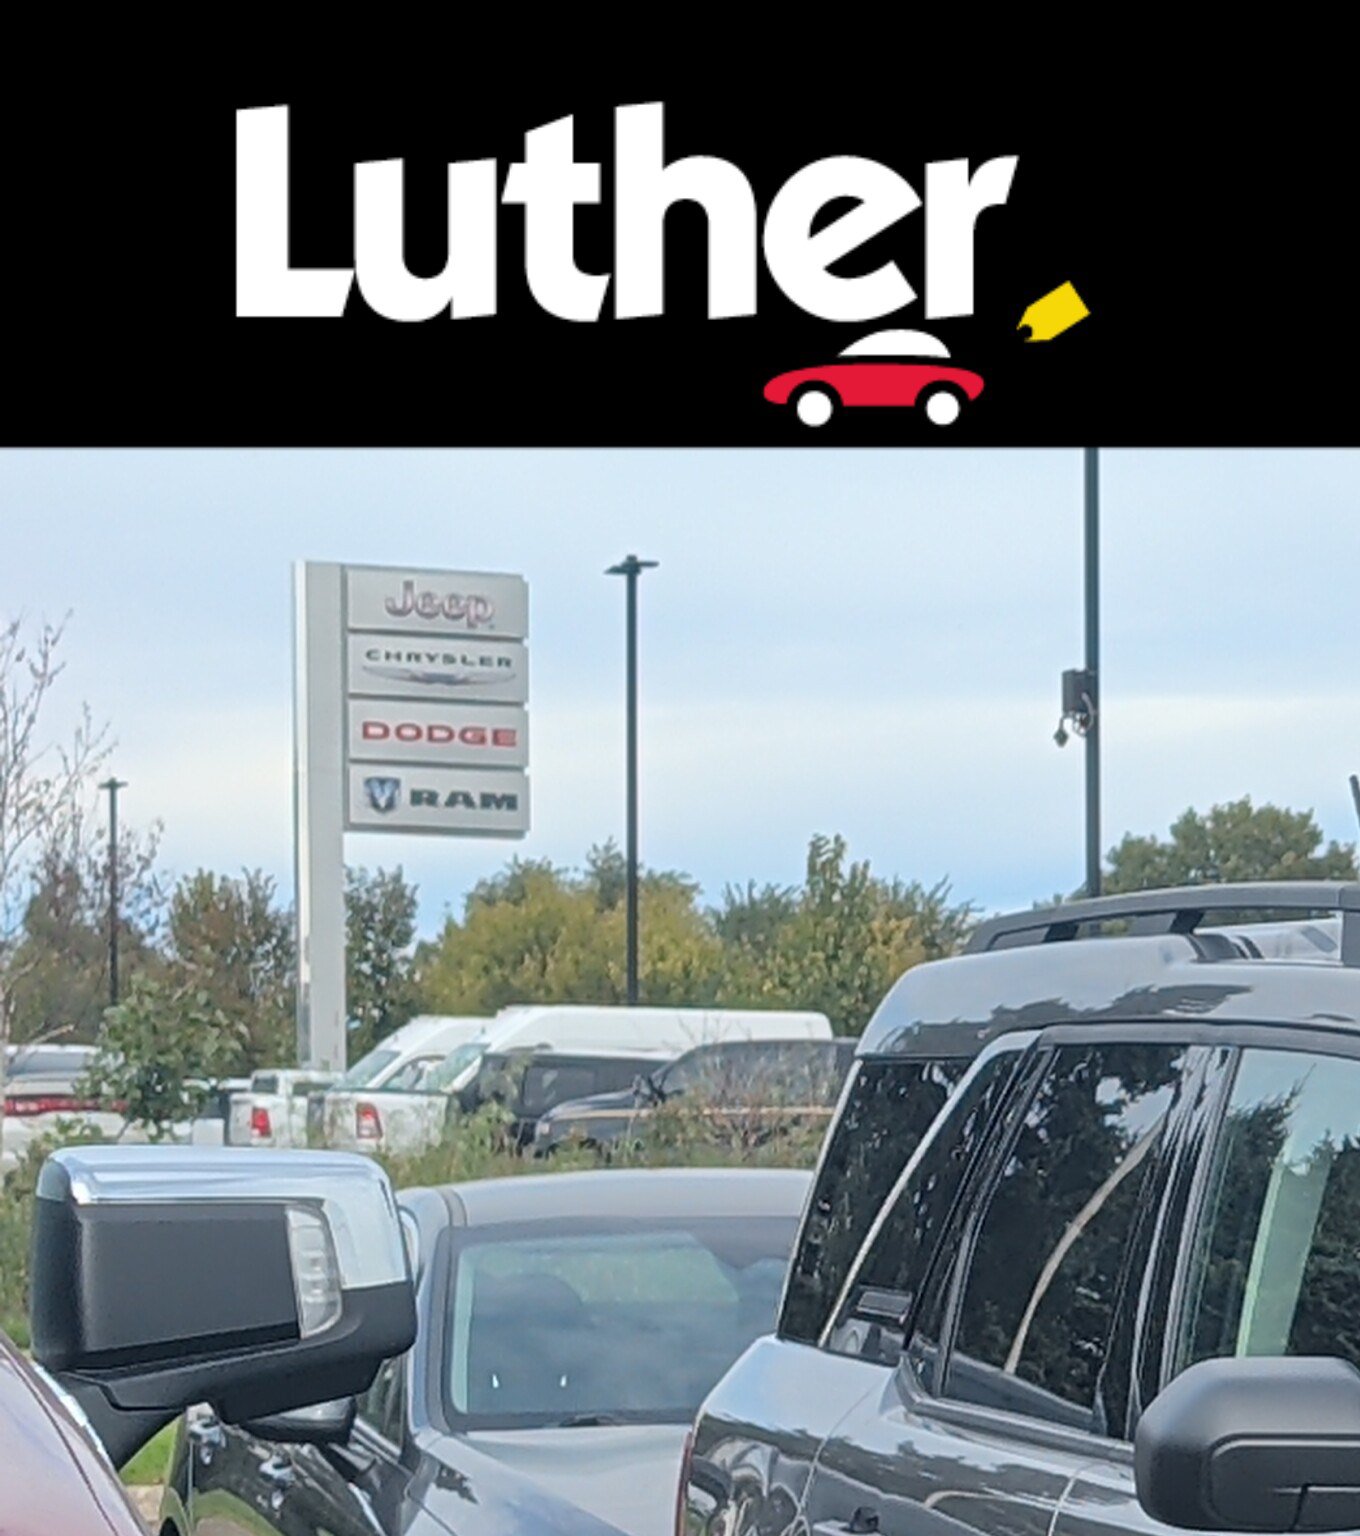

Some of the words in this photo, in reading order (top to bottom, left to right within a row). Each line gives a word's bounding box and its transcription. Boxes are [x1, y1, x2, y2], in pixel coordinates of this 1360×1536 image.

[384, 579, 495, 629] Jeep
[365, 649, 512, 668] CHRYSLER
[362, 721, 517, 747] DODGE
[410, 788, 518, 811] RAM
